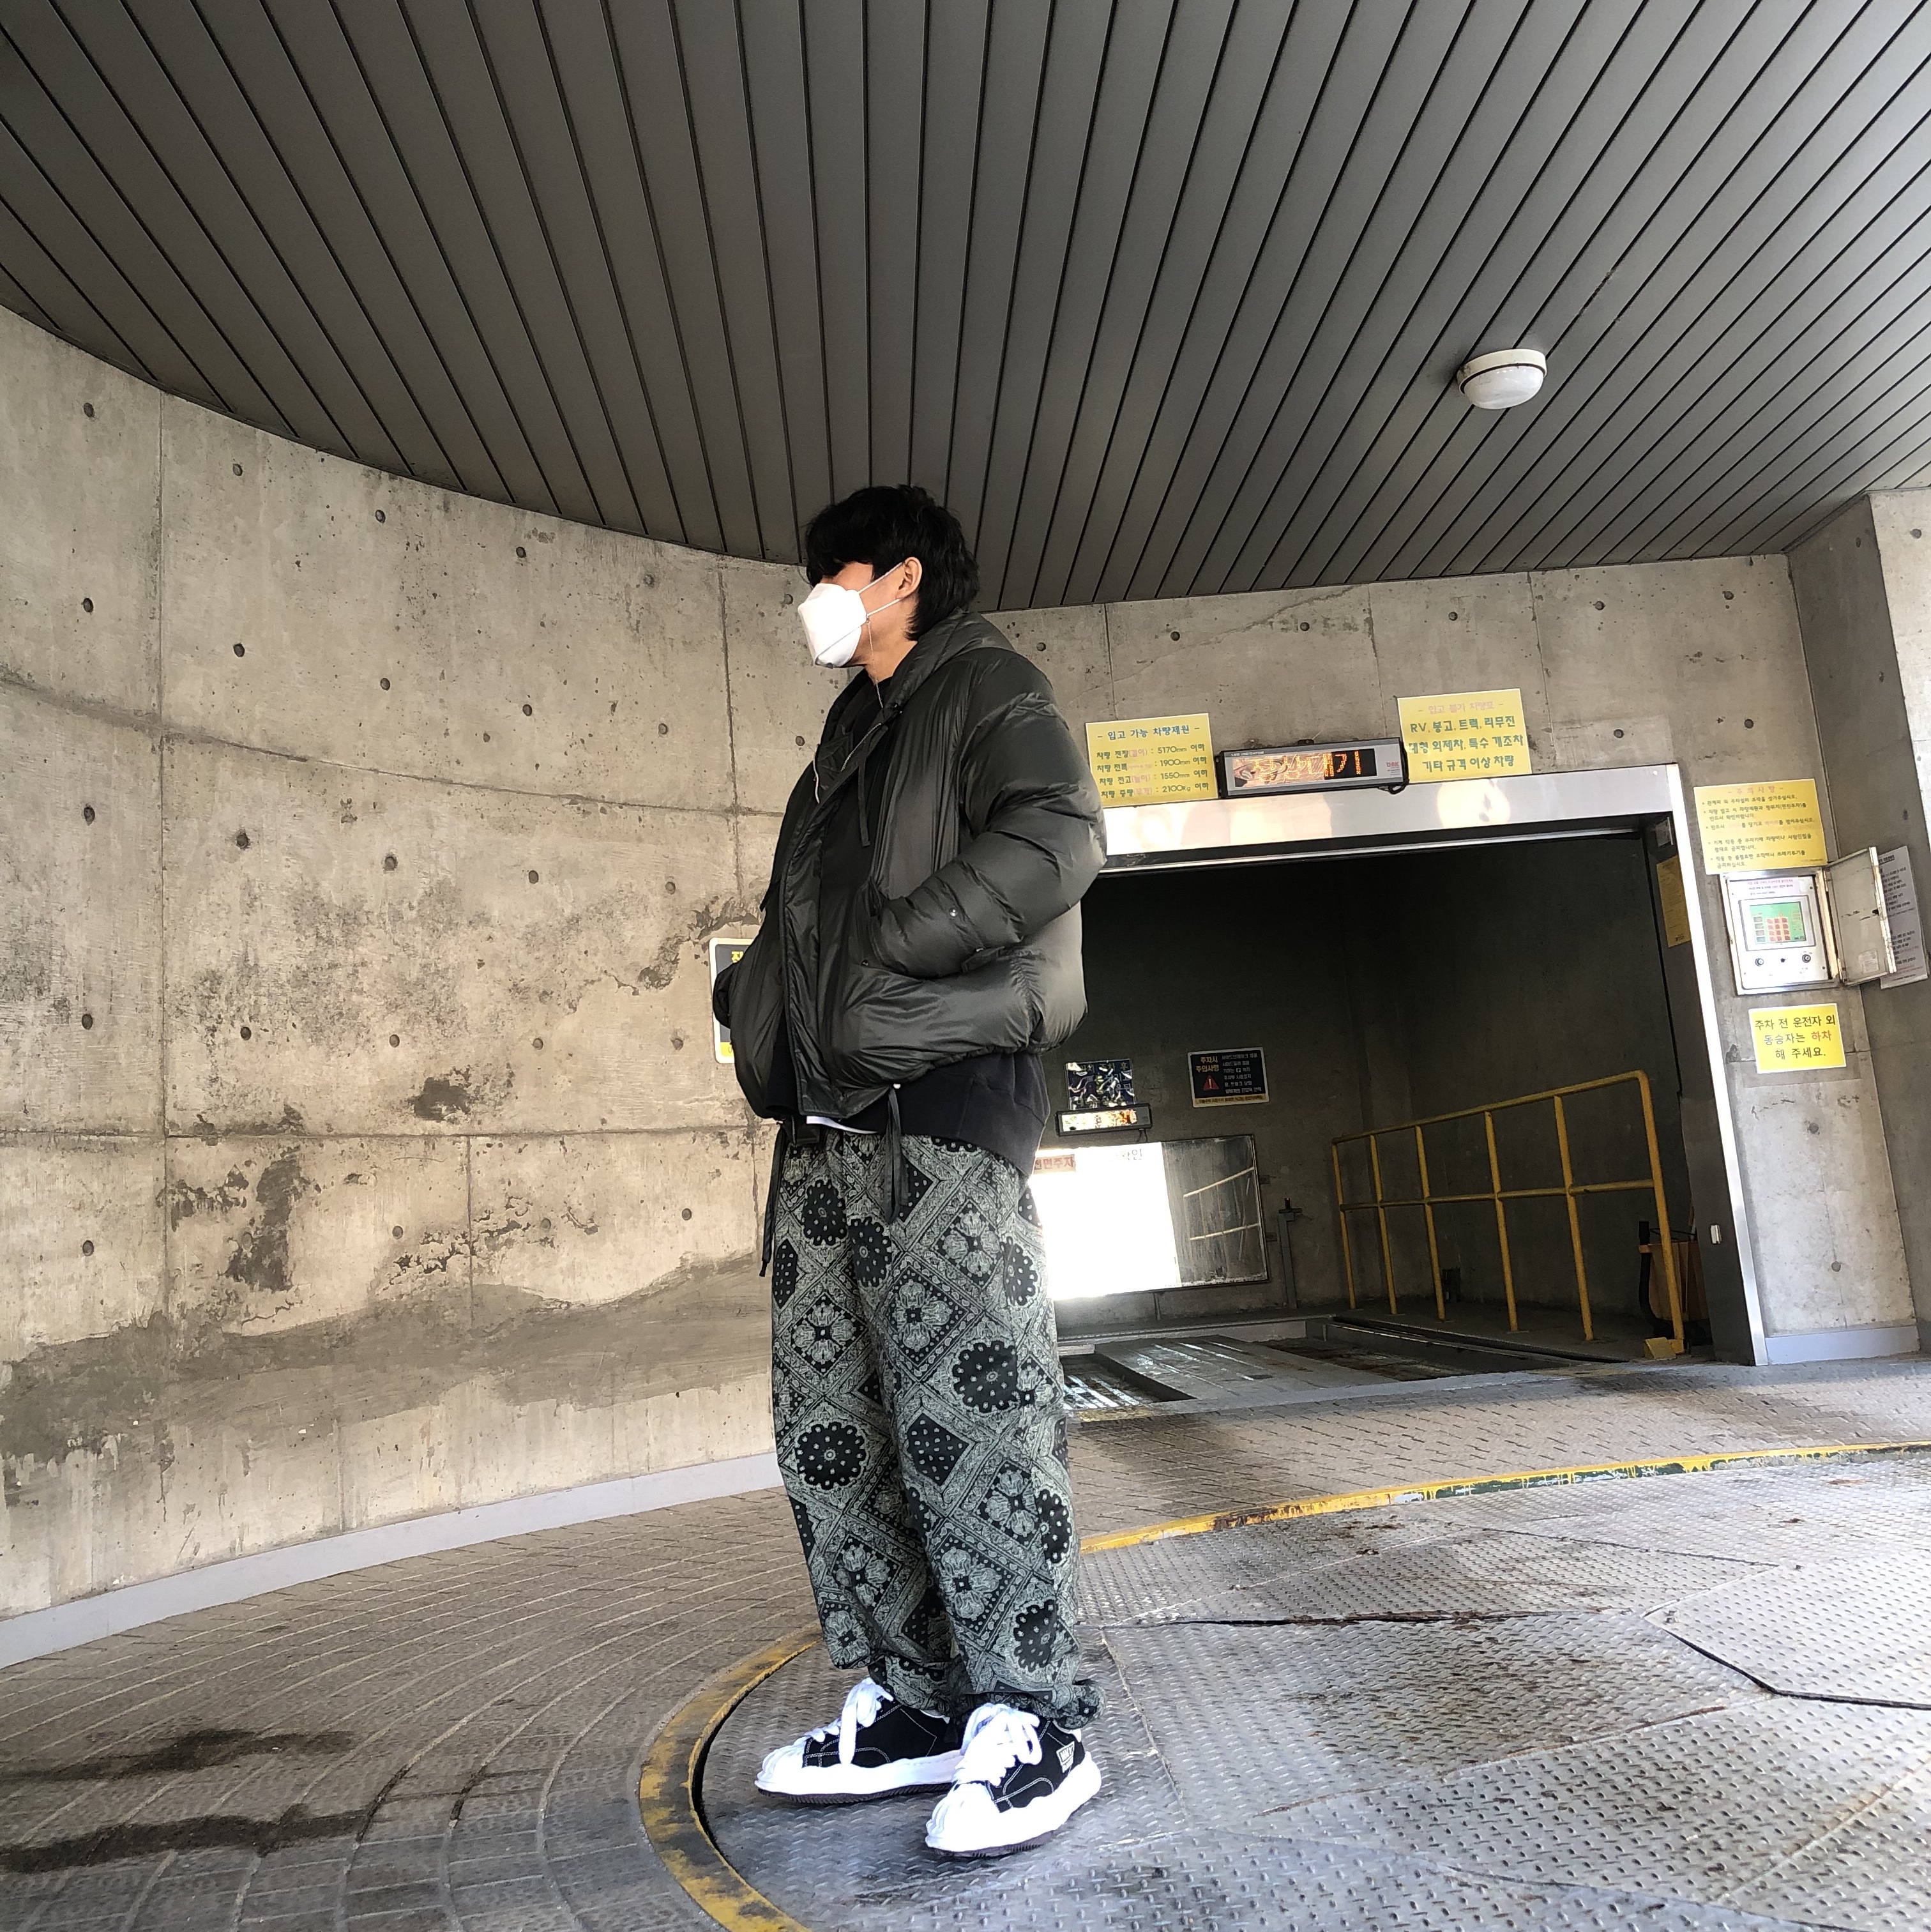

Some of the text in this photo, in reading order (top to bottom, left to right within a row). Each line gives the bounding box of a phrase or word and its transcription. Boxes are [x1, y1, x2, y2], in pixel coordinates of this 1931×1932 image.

[1484, 715, 1516, 728] 리무진
[1108, 725, 1190, 740] 입고 가능 차량제원
[1190, 743, 1205, 752] 이하
[1469, 737, 1489, 749] 특수
[1492, 734, 1524, 747] 개조차
[1097, 764, 1111, 773] 차량
[1193, 756, 1206, 764] 이하
[1422, 755, 1514, 773] 기타 규격 이상 차량
[1100, 777, 1113, 786] 차량
[1160, 772, 1190, 780] 1550mm
[1193, 770, 1208, 778] 이하
[1101, 790, 1115, 798] 차량
[1194, 782, 1209, 791] 이하
[1755, 1014, 1836, 1030] 주차 전 운전자 외
[1764, 1030, 1832, 1046] 동승자는 하차
[1775, 1049, 1785, 1060] 해
